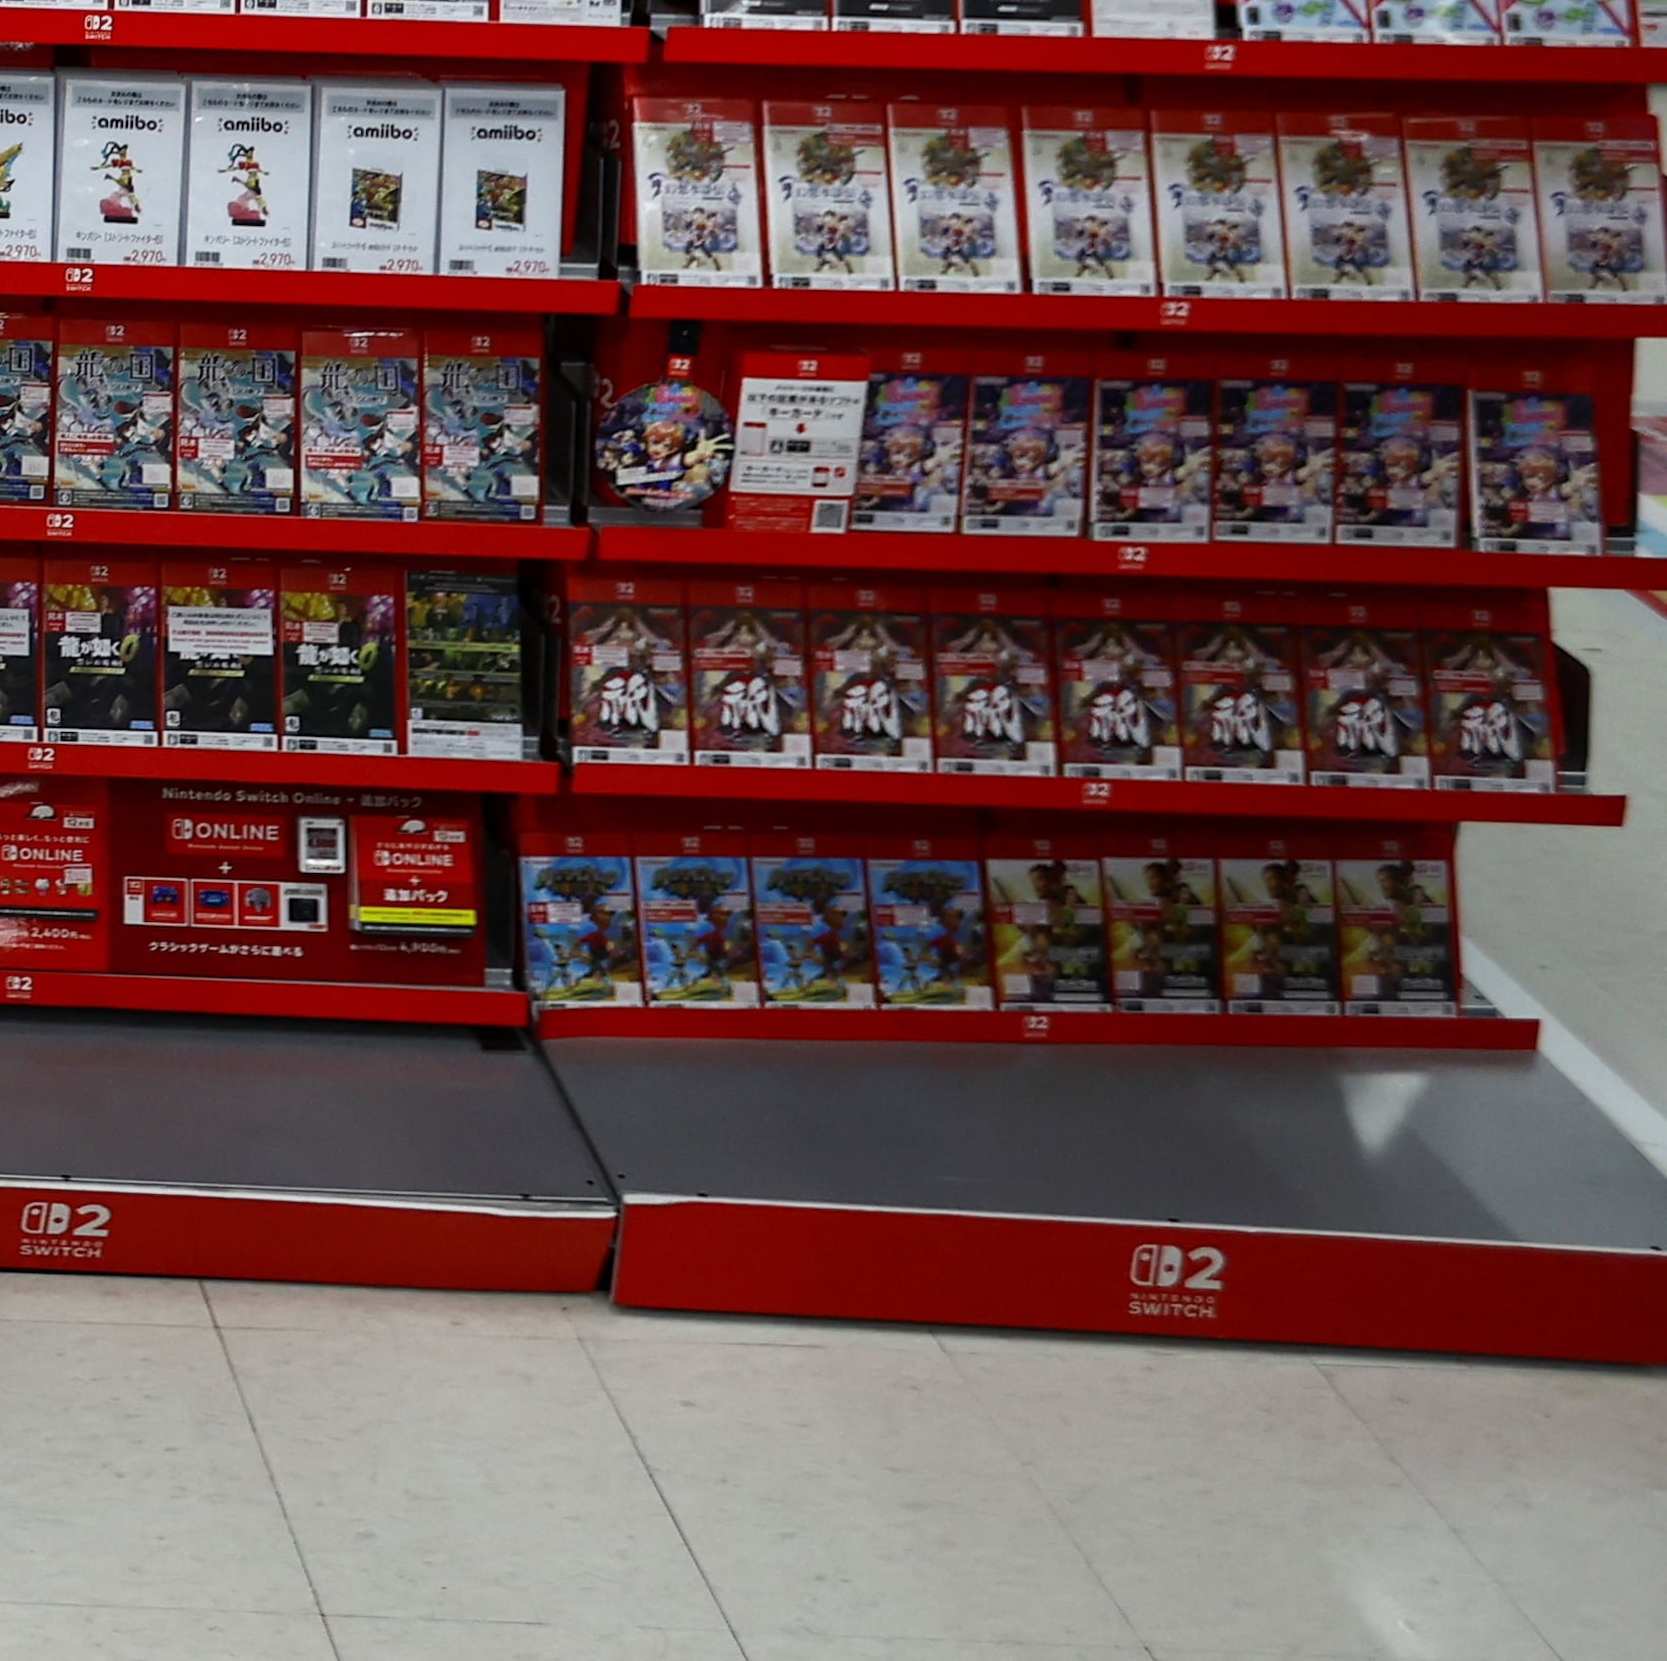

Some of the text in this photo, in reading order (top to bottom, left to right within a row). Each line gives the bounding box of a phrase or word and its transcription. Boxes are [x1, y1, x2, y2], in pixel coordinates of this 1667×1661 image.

[98, 116, 157, 132] amiibo
[224, 118, 283, 133] amiibo
[353, 125, 413, 140] amiibo
[162, 787, 232, 802] Nintendo
[236, 789, 289, 804] Switch
[195, 822, 280, 841] ONLINE
[18, 845, 84, 862] ONLINE
[391, 851, 454, 867] ONLINE
[73, 1205, 110, 1237] 2
[20, 1245, 101, 1257] SWITCH
[1185, 1247, 1225, 1290] 2
[1129, 1301, 1215, 1317] SWITCH
